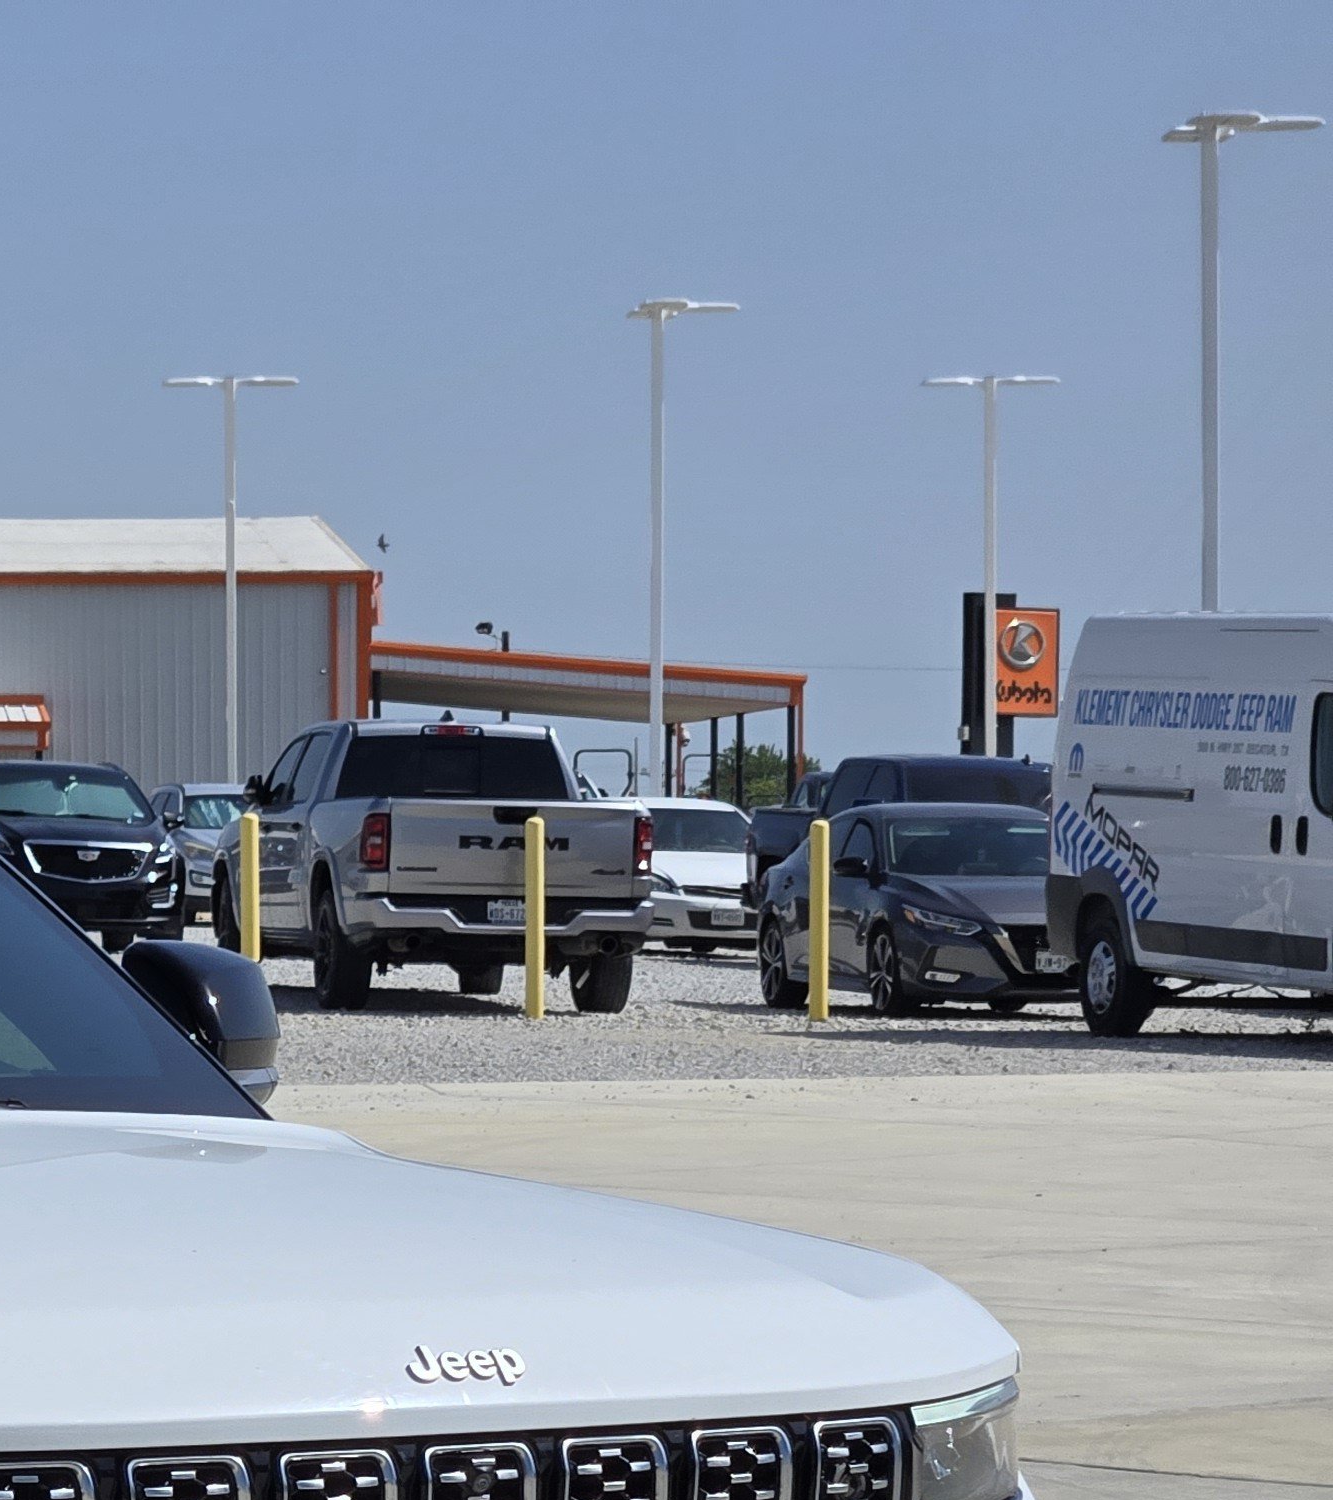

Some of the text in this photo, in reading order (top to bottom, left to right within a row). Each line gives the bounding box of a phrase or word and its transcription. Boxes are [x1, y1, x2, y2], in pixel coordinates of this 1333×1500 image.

[1074, 688, 1297, 733] KLEMENT CHRYSLER DODGE JEEP RAM
[458, 835, 570, 851] RAM
[1085, 799, 1161, 890] MOPAR
[405, 1344, 526, 1386] Jeep
